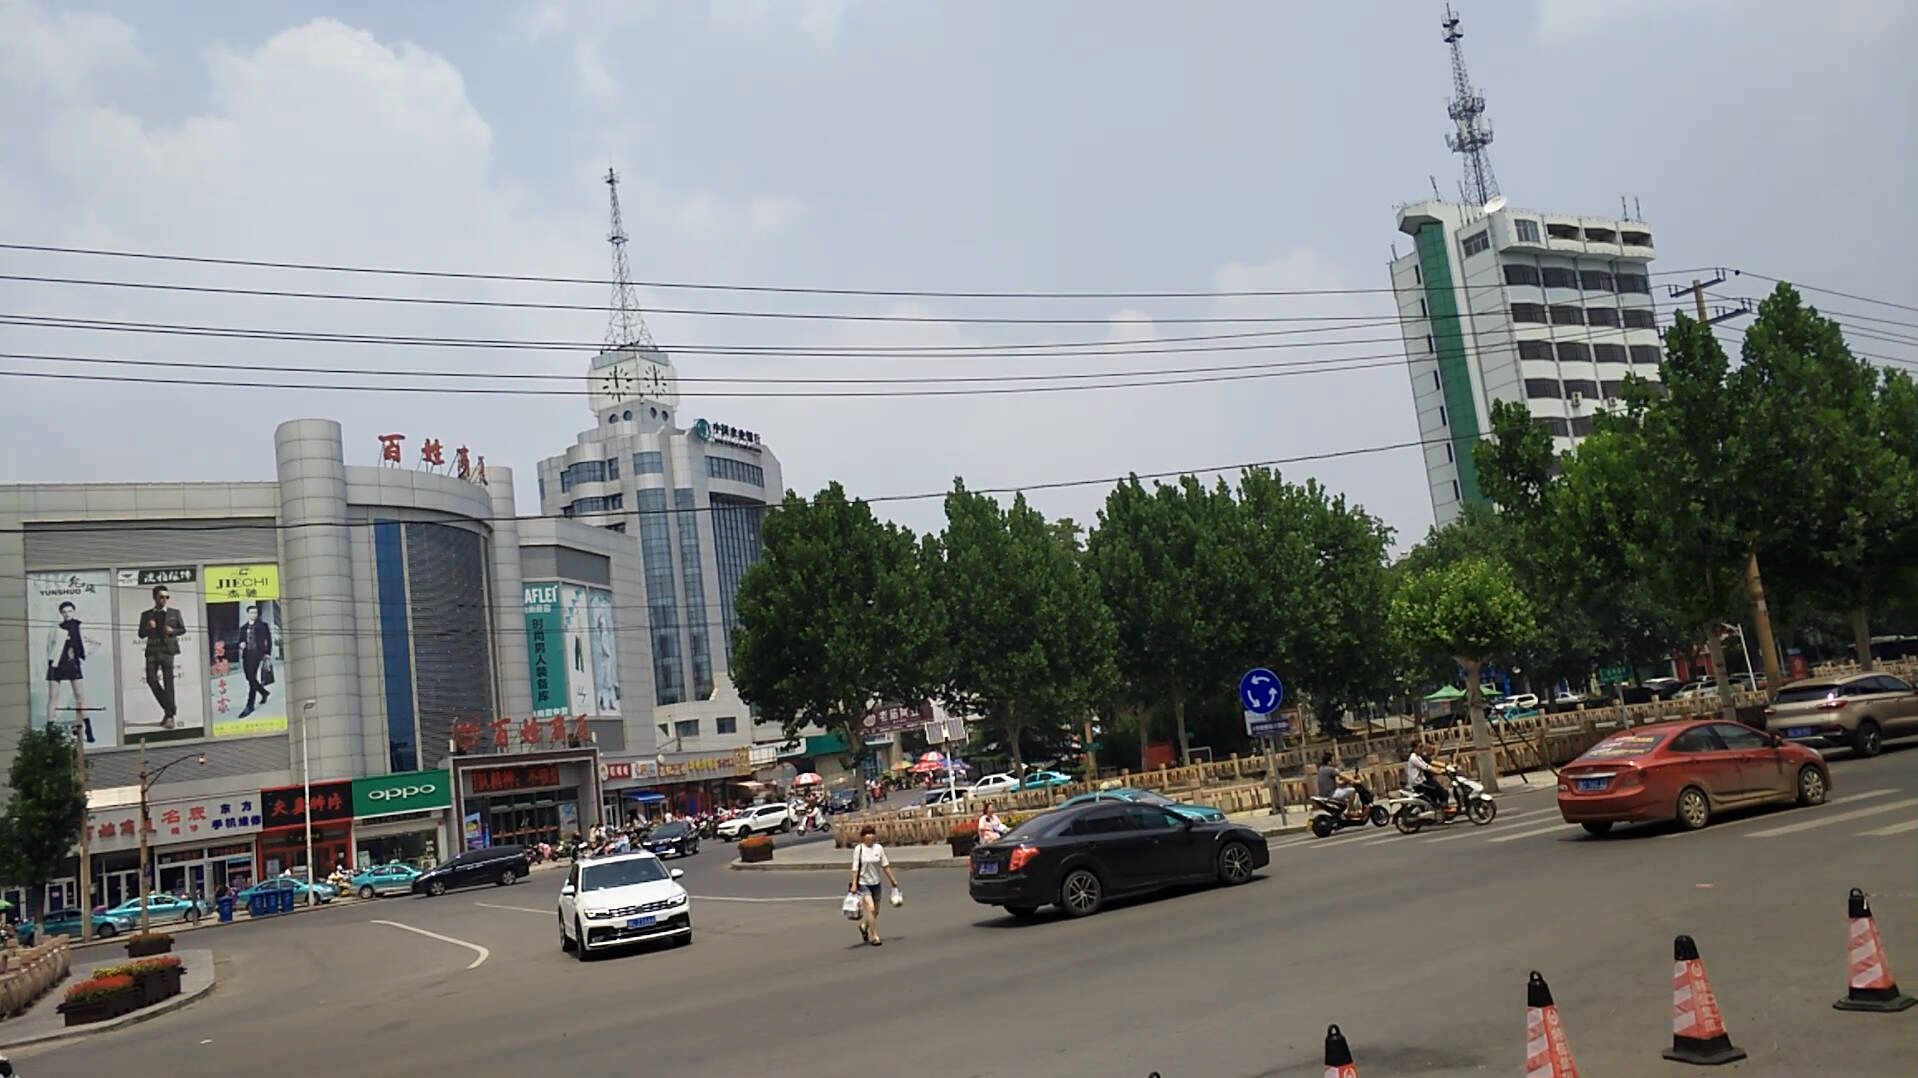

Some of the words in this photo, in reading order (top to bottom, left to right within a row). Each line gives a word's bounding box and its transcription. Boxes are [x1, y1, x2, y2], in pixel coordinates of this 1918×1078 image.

[216, 577, 269, 590] JIECHI
[40, 588, 81, 596] YUNSHUO
[532, 617, 549, 702] 时尚男人装备库
[220, 801, 252, 814] 东方
[211, 815, 261, 830] 手机维修
